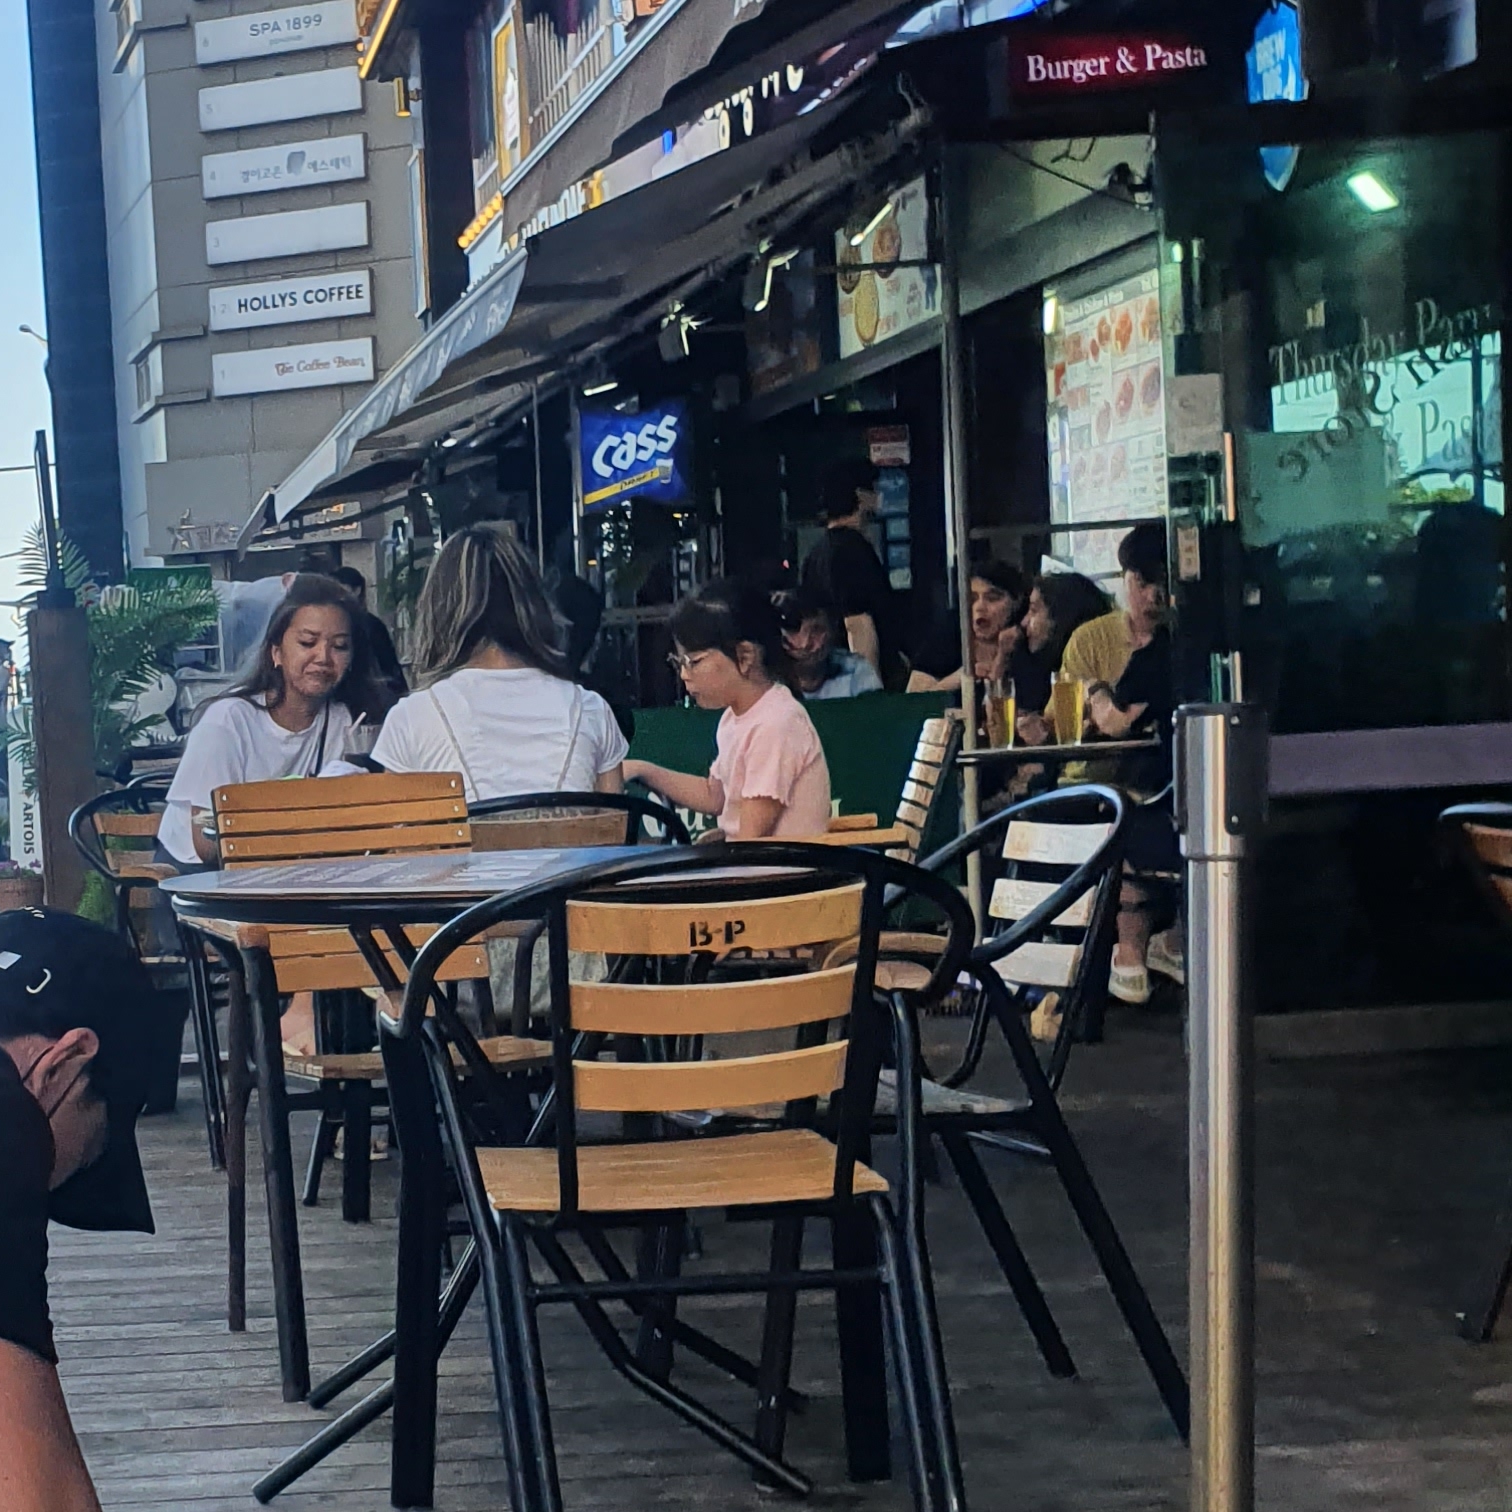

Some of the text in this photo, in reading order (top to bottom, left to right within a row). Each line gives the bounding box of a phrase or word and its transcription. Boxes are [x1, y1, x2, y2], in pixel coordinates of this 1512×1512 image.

[249, 14, 323, 37] SPA 1899
[1027, 44, 1208, 83] Burger & Pasta
[237, 283, 364, 314] HOLLYS COFFEE
[296, 358, 331, 374] Coffee
[22, 802, 35, 855] ARTOIS
